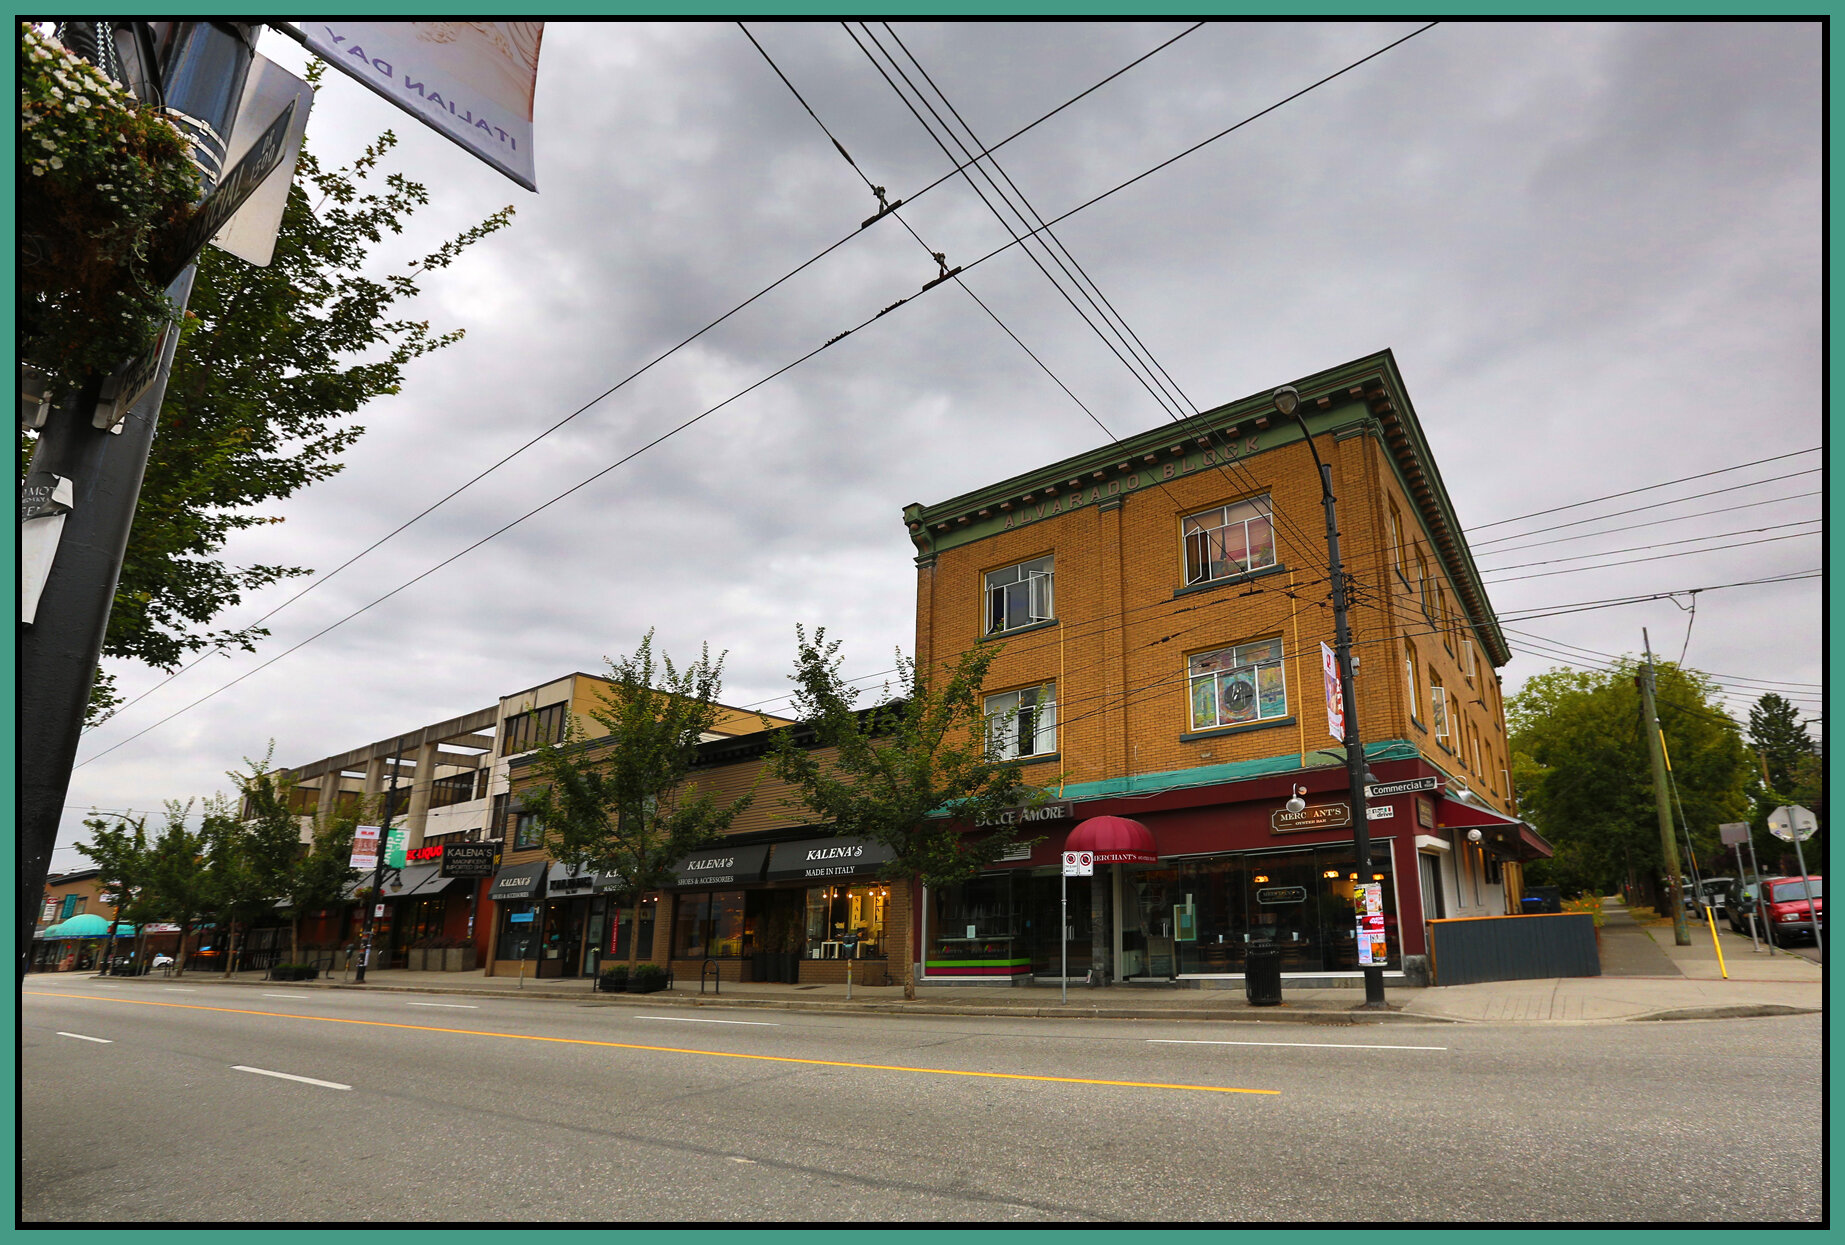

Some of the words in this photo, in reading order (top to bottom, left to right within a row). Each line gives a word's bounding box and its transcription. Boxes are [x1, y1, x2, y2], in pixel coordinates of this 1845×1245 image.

[251, 144, 276, 183] 1500
[1004, 474, 1140, 529] ALVARADO
[1162, 436, 1260, 479] BLOCK
[1372, 781, 1422, 794] Commercial
[1020, 805, 1065, 823] AMORE
[1280, 807, 1341, 822] MERCANT'S
[447, 848, 492, 857] KALENA'S
[806, 845, 863, 861] KALENA'S
[687, 857, 735, 870] KALENA'S
[805, 868, 825, 877] MADE
[826, 867, 834, 875] IN
[834, 866, 855, 875] ITALY
[677, 878, 694, 886] SHOES
[699, 875, 734, 885] ACCESSORIES
